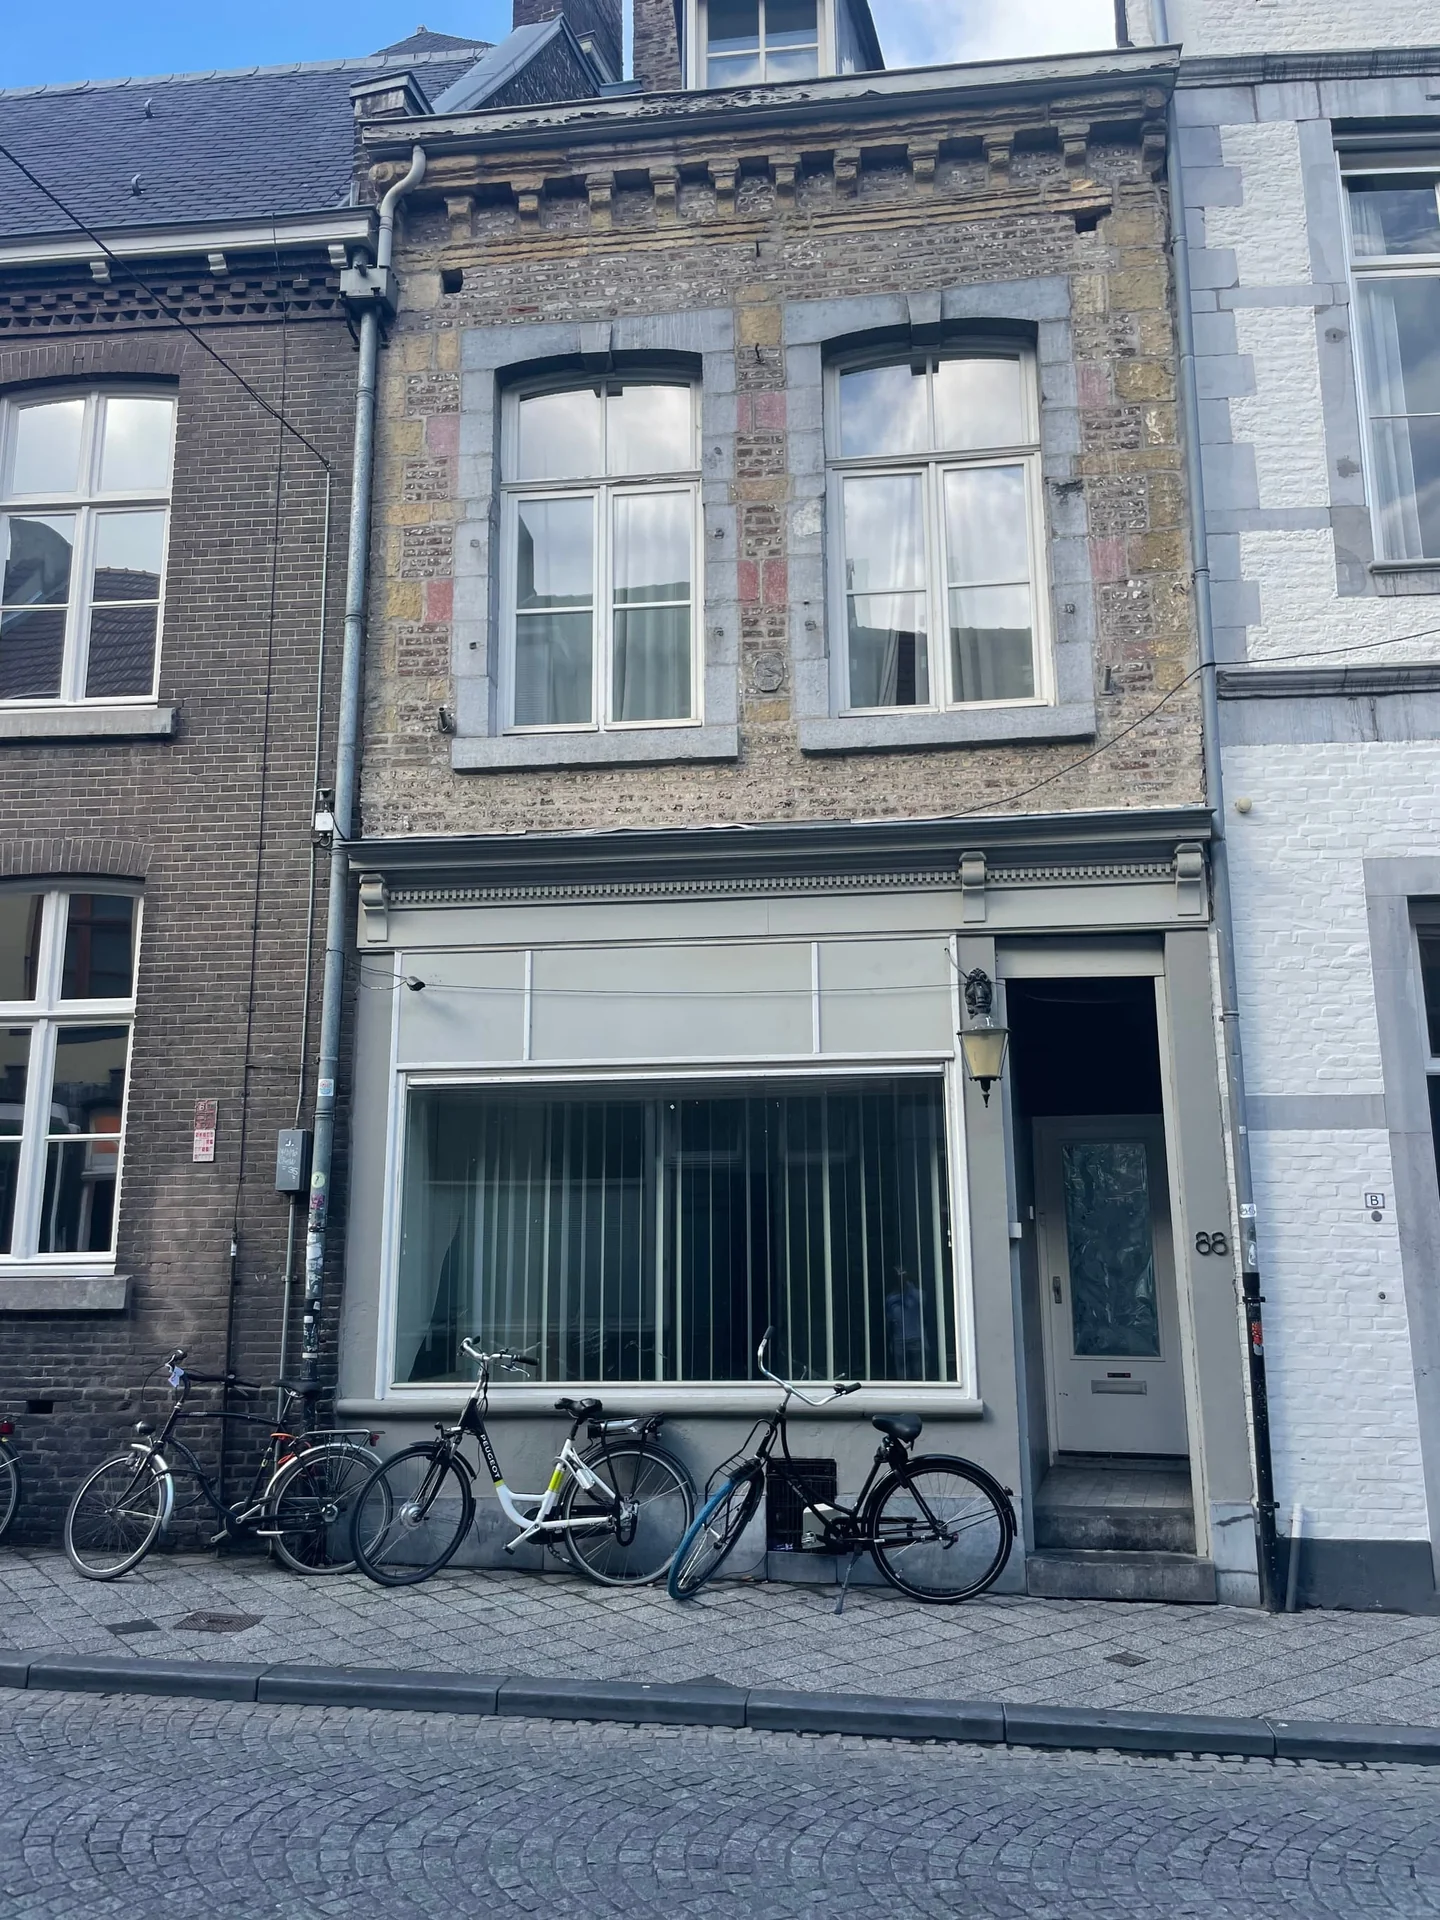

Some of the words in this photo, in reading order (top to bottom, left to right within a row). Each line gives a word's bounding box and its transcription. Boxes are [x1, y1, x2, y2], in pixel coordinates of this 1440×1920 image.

[1370, 1195, 1379, 1206] B
[1195, 1231, 1228, 1256] 88
[480, 1434, 500, 1478] PEUGEOT
